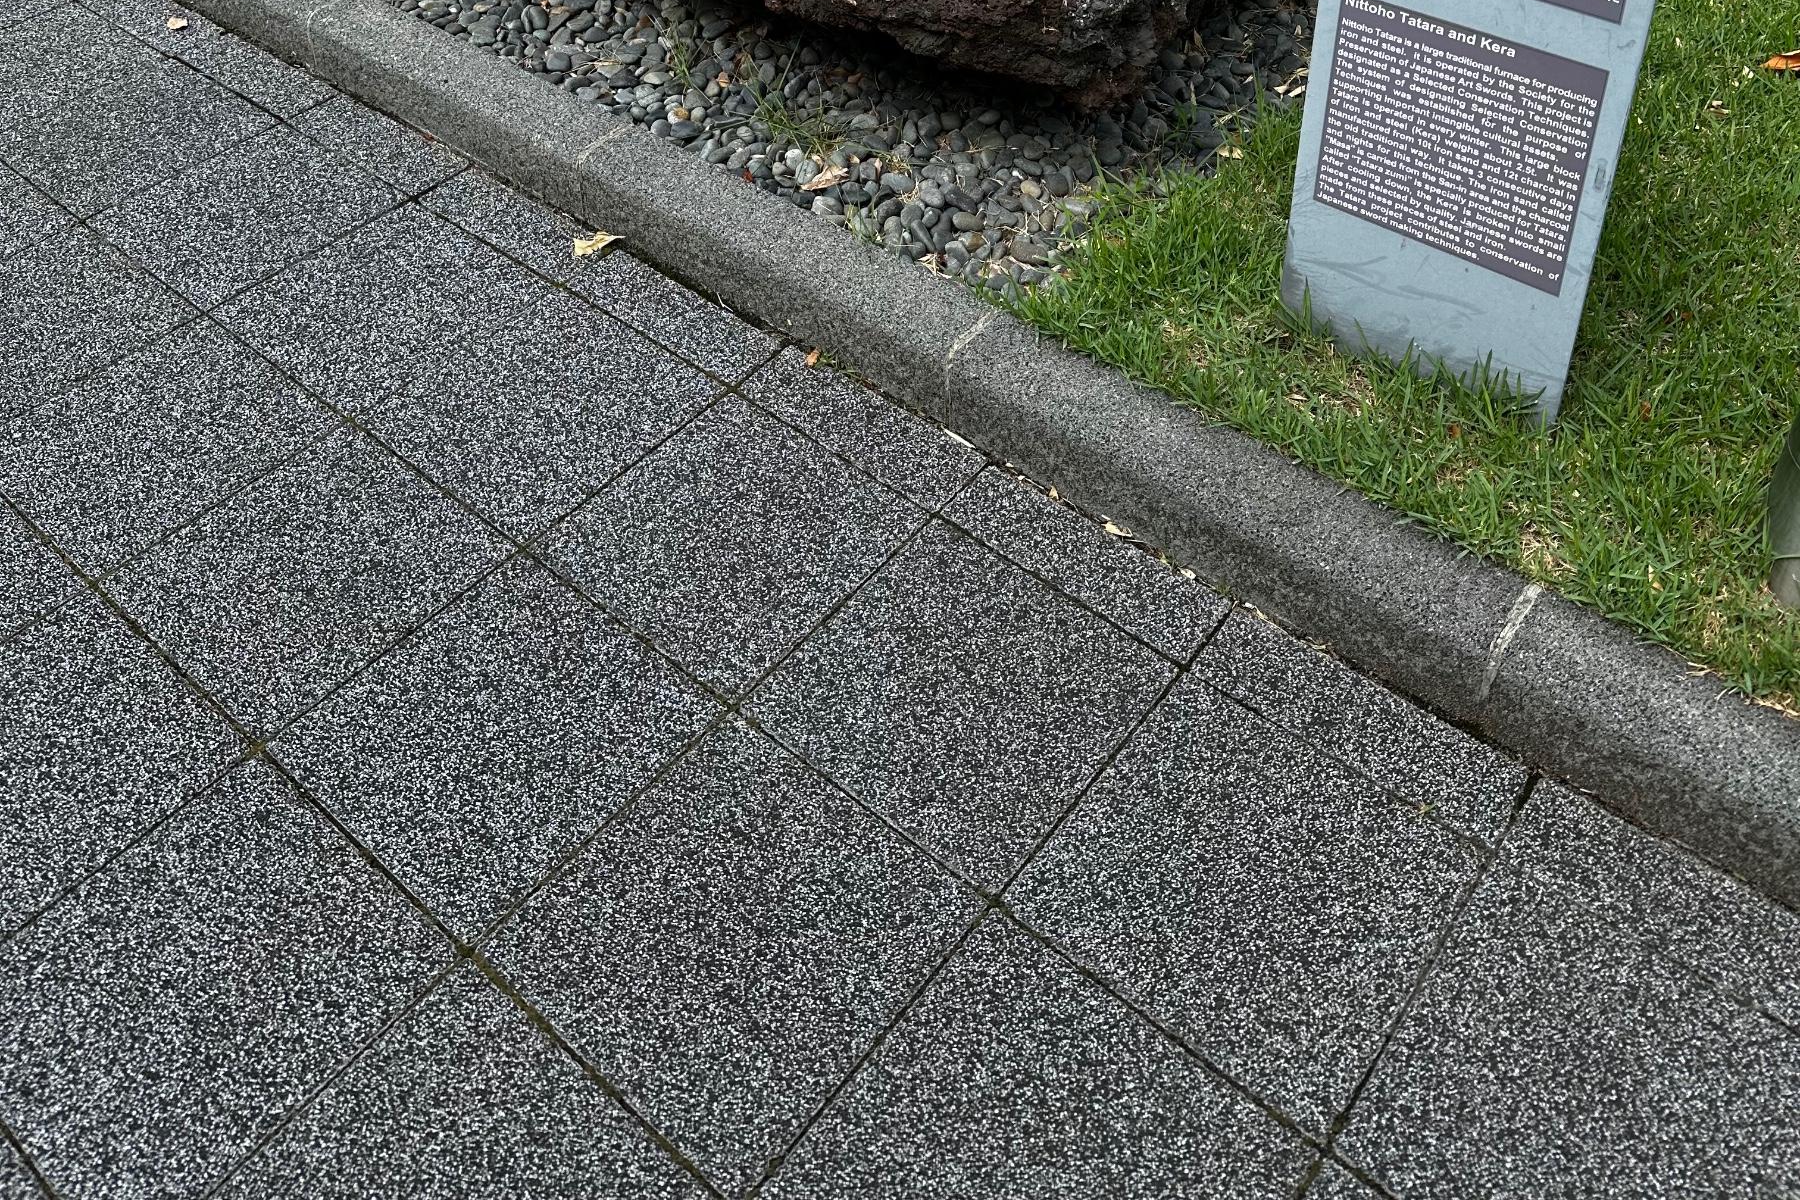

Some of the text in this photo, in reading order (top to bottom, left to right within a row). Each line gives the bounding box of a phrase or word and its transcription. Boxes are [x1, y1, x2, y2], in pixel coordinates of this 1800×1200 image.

[1340, 27, 1576, 111] iron and steel. operated Society for
[1341, 17, 1598, 109] Nittoho Tatara large traditional furnace producing
[1399, 10, 1445, 36] Tatara
[1447, 29, 1477, 46] and
[1479, 36, 1516, 58] Kera
[1332, 78, 1559, 163] supporting important intangible cultural assets.
[1334, 66, 1387, 92] Techniques
[1392, 88, 1412, 101] was
[1417, 97, 1475, 122] established
[1524, 133, 1568, 154] purpose
[1336, 56, 1588, 150] The system designating Selected Conservation
[1337, 48, 1590, 139] designated as Selected Conservation Techniques.
[1338, 37, 1582, 125] Preservation Japanese Art Swords. This project
[1326, 126, 1573, 223] and nights for this technique. The iron sand called
[1328, 107, 1565, 198] manufactured from 10t iron sand and 12t charcoal
[1332, 86, 1581, 181] Tatara operated every winter. This large block
[1342, 100, 1579, 192] iron and steel (Kera) weighs about 2.5t. It was
[1343, 123, 1574, 212] old traditional way. It takes 3 consecutive days
[1316, 190, 1480, 261] Japanese sword making techniques.
[1318, 180, 1544, 276] The Tatara project contributes conservation
[1319, 173, 1507, 251] made from these pieces steel and iron.
[1320, 164, 1349, 180] pieces
[1350, 175, 1369, 187] and
[1369, 182, 1409, 203] selected
[1423, 203, 1458, 222] quality.
[1508, 236, 1545, 255] swords
[1546, 251, 1563, 262] are
[1321, 154, 1566, 253] After cooling down, Kera broken into small
[1323, 145, 1567, 243] called "Tatara zumi" specially produced for Tatara.
[1325, 134, 1570, 233] "Masa" carried from San-in area and charcoal
